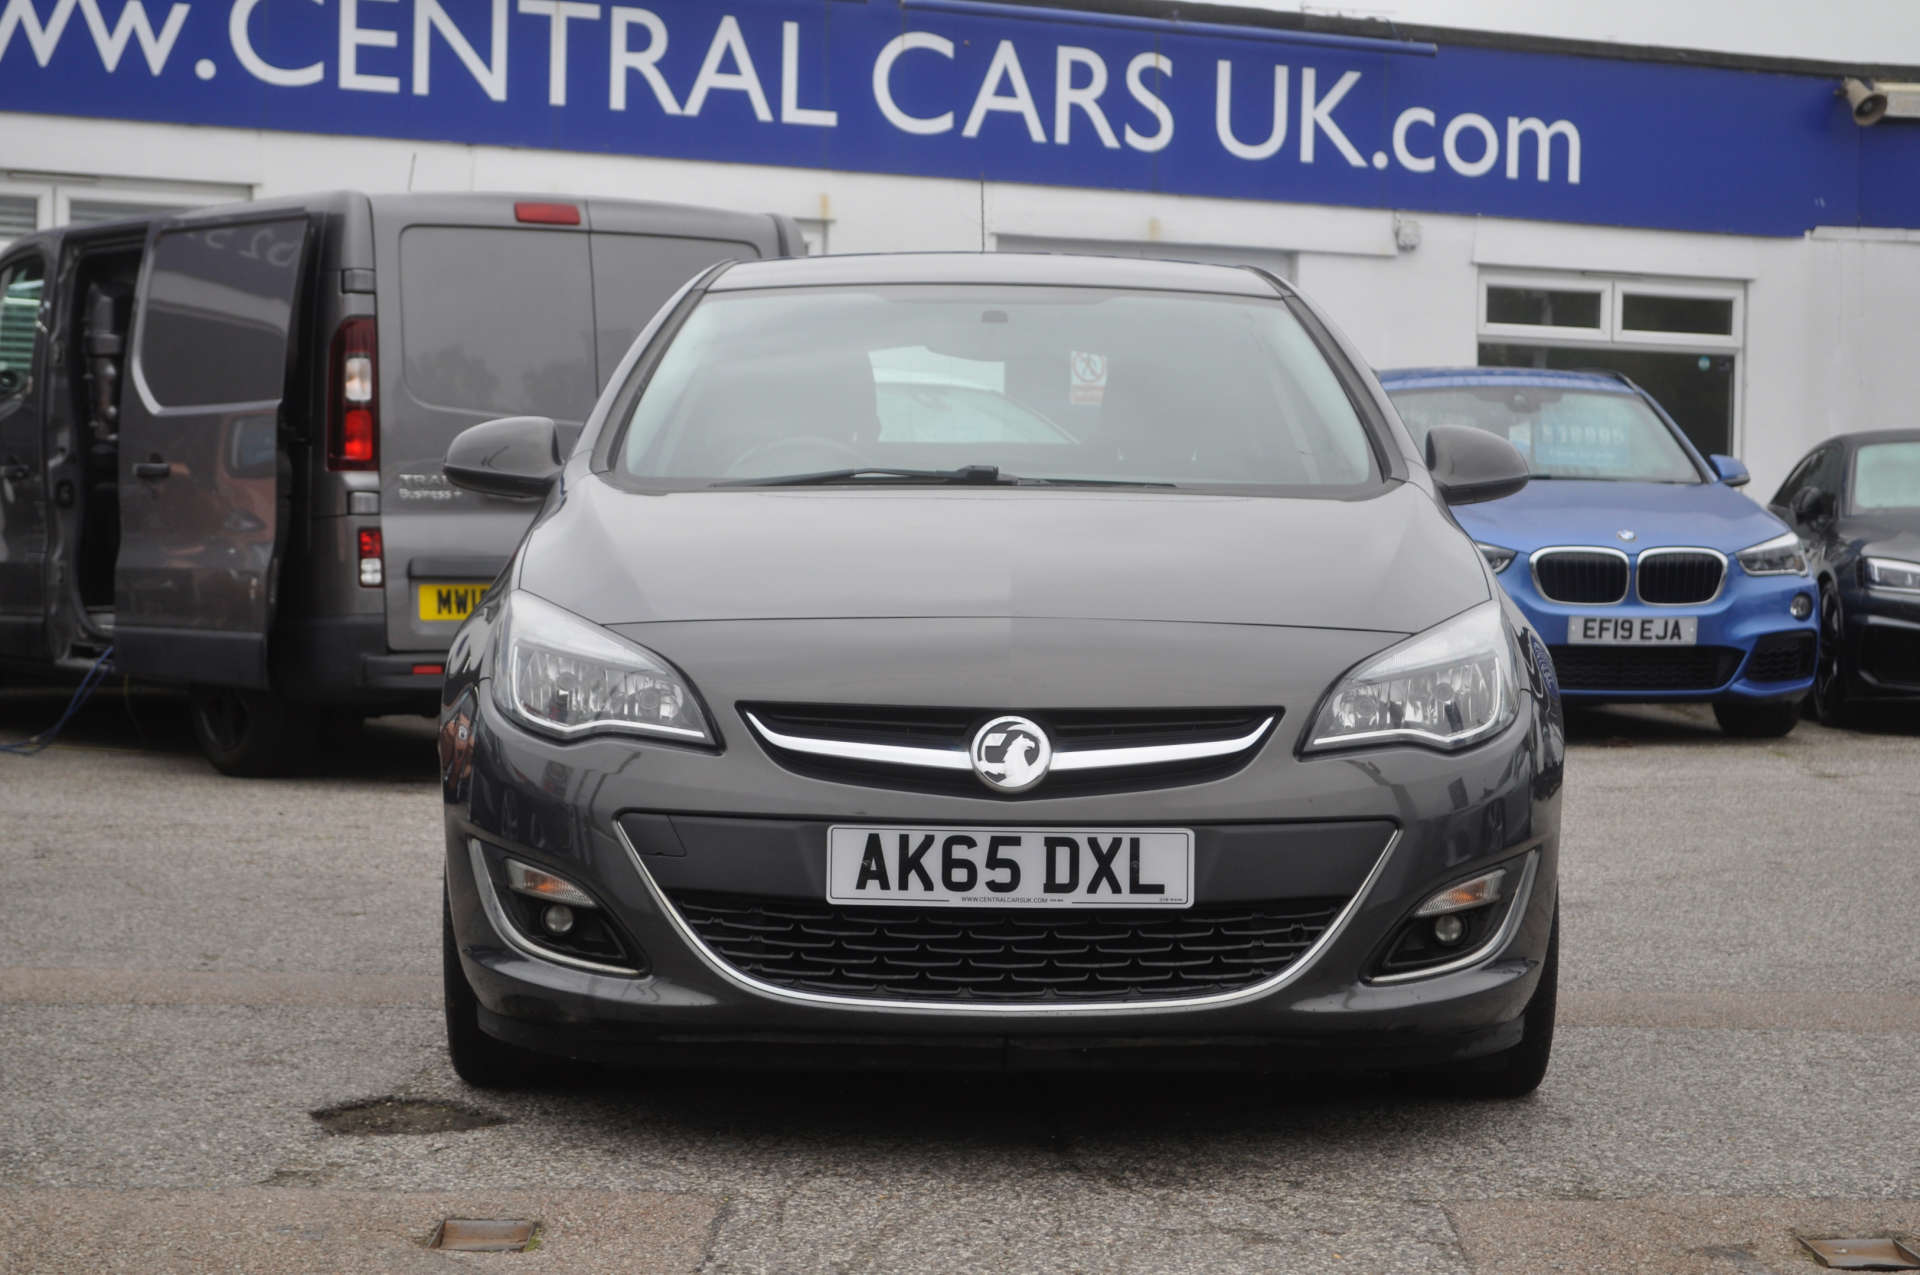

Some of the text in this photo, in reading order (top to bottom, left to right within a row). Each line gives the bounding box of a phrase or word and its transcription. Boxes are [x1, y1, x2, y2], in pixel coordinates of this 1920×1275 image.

[872, 31, 1175, 153] CARS
[1216, 59, 1582, 184] UK.com
[1582, 617, 1682, 641] EF19 EJA
[855, 833, 1166, 895] AK65 DXL
